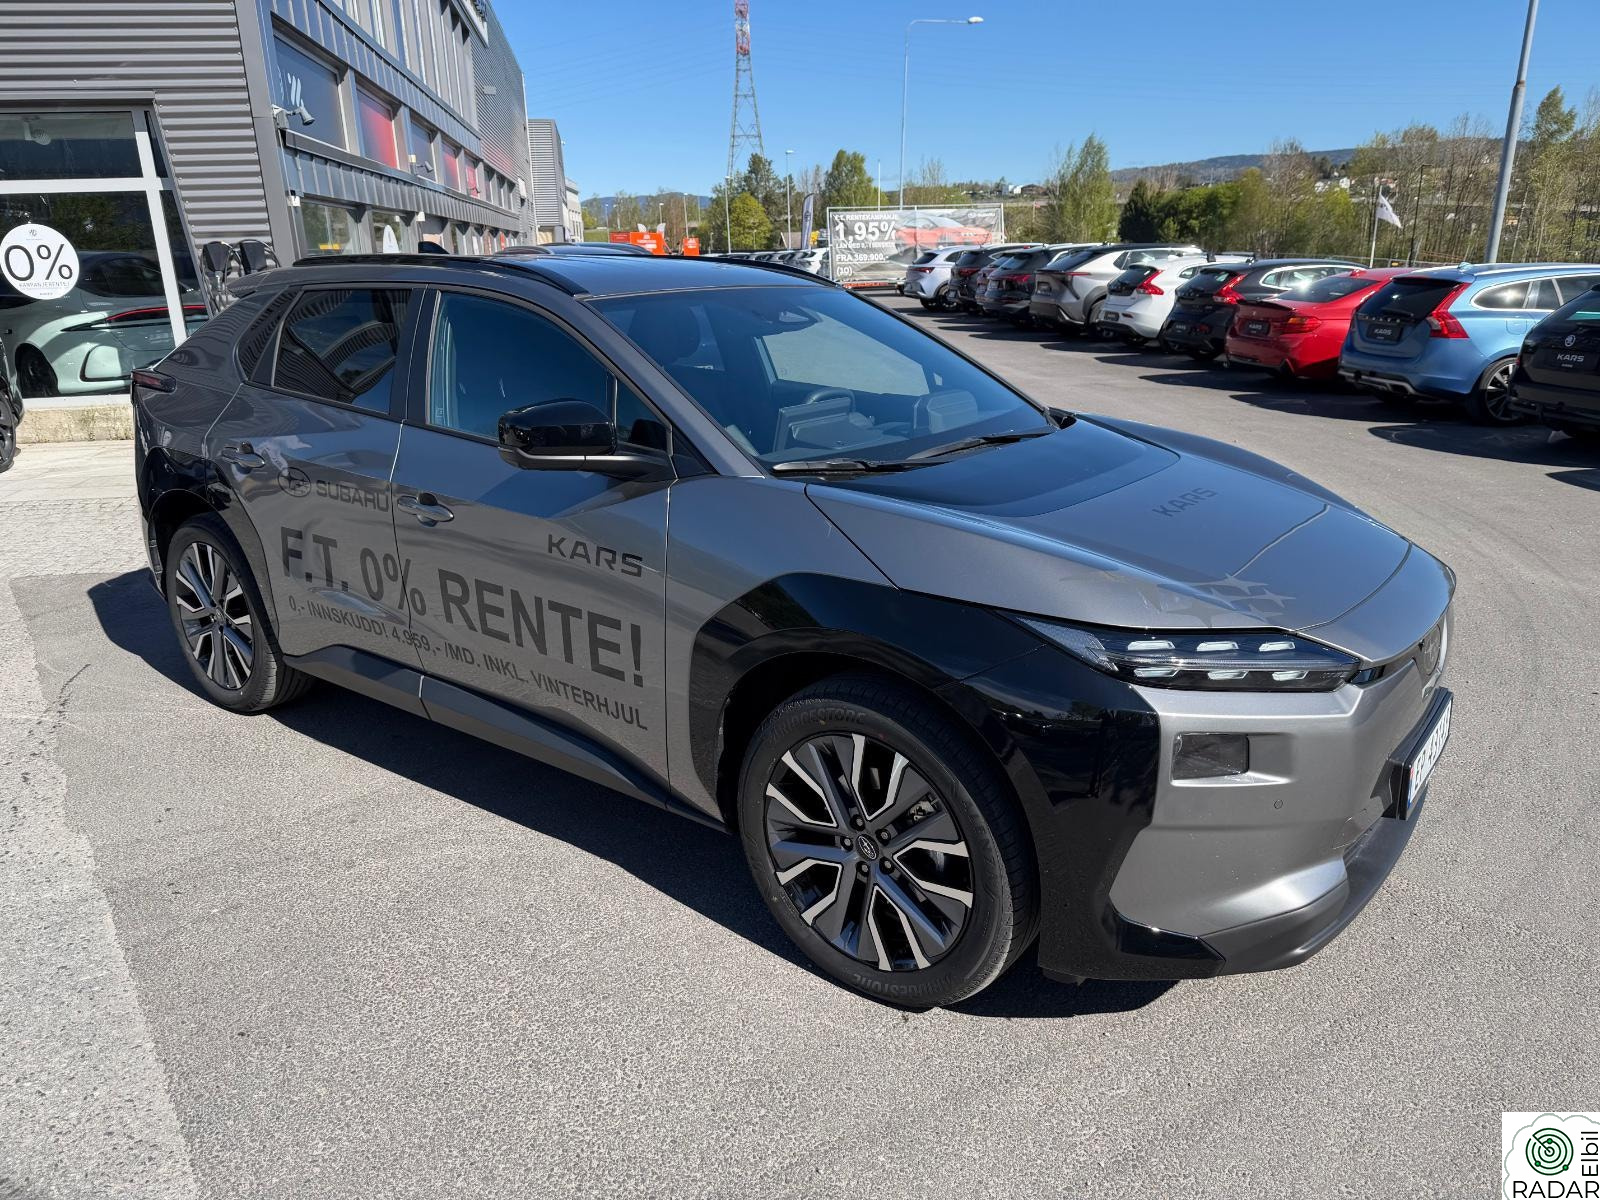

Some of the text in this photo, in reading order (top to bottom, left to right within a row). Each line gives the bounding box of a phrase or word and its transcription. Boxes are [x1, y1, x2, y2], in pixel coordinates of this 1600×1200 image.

[835, 221, 897, 244] 1,95%
[4, 244, 73, 282] 0%
[836, 254, 853, 262] FRA
[1557, 354, 1585, 362] KARS
[316, 479, 389, 512] SUBARU
[1151, 488, 1219, 518] KARS
[547, 534, 643, 578] KARS
[281, 526, 644, 688] F.T. 0% RENTE!
[306, 599, 389, 638] INNSKUDD!
[482, 653, 529, 684] INKL.
[529, 670, 648, 731] VINTERHJUL
